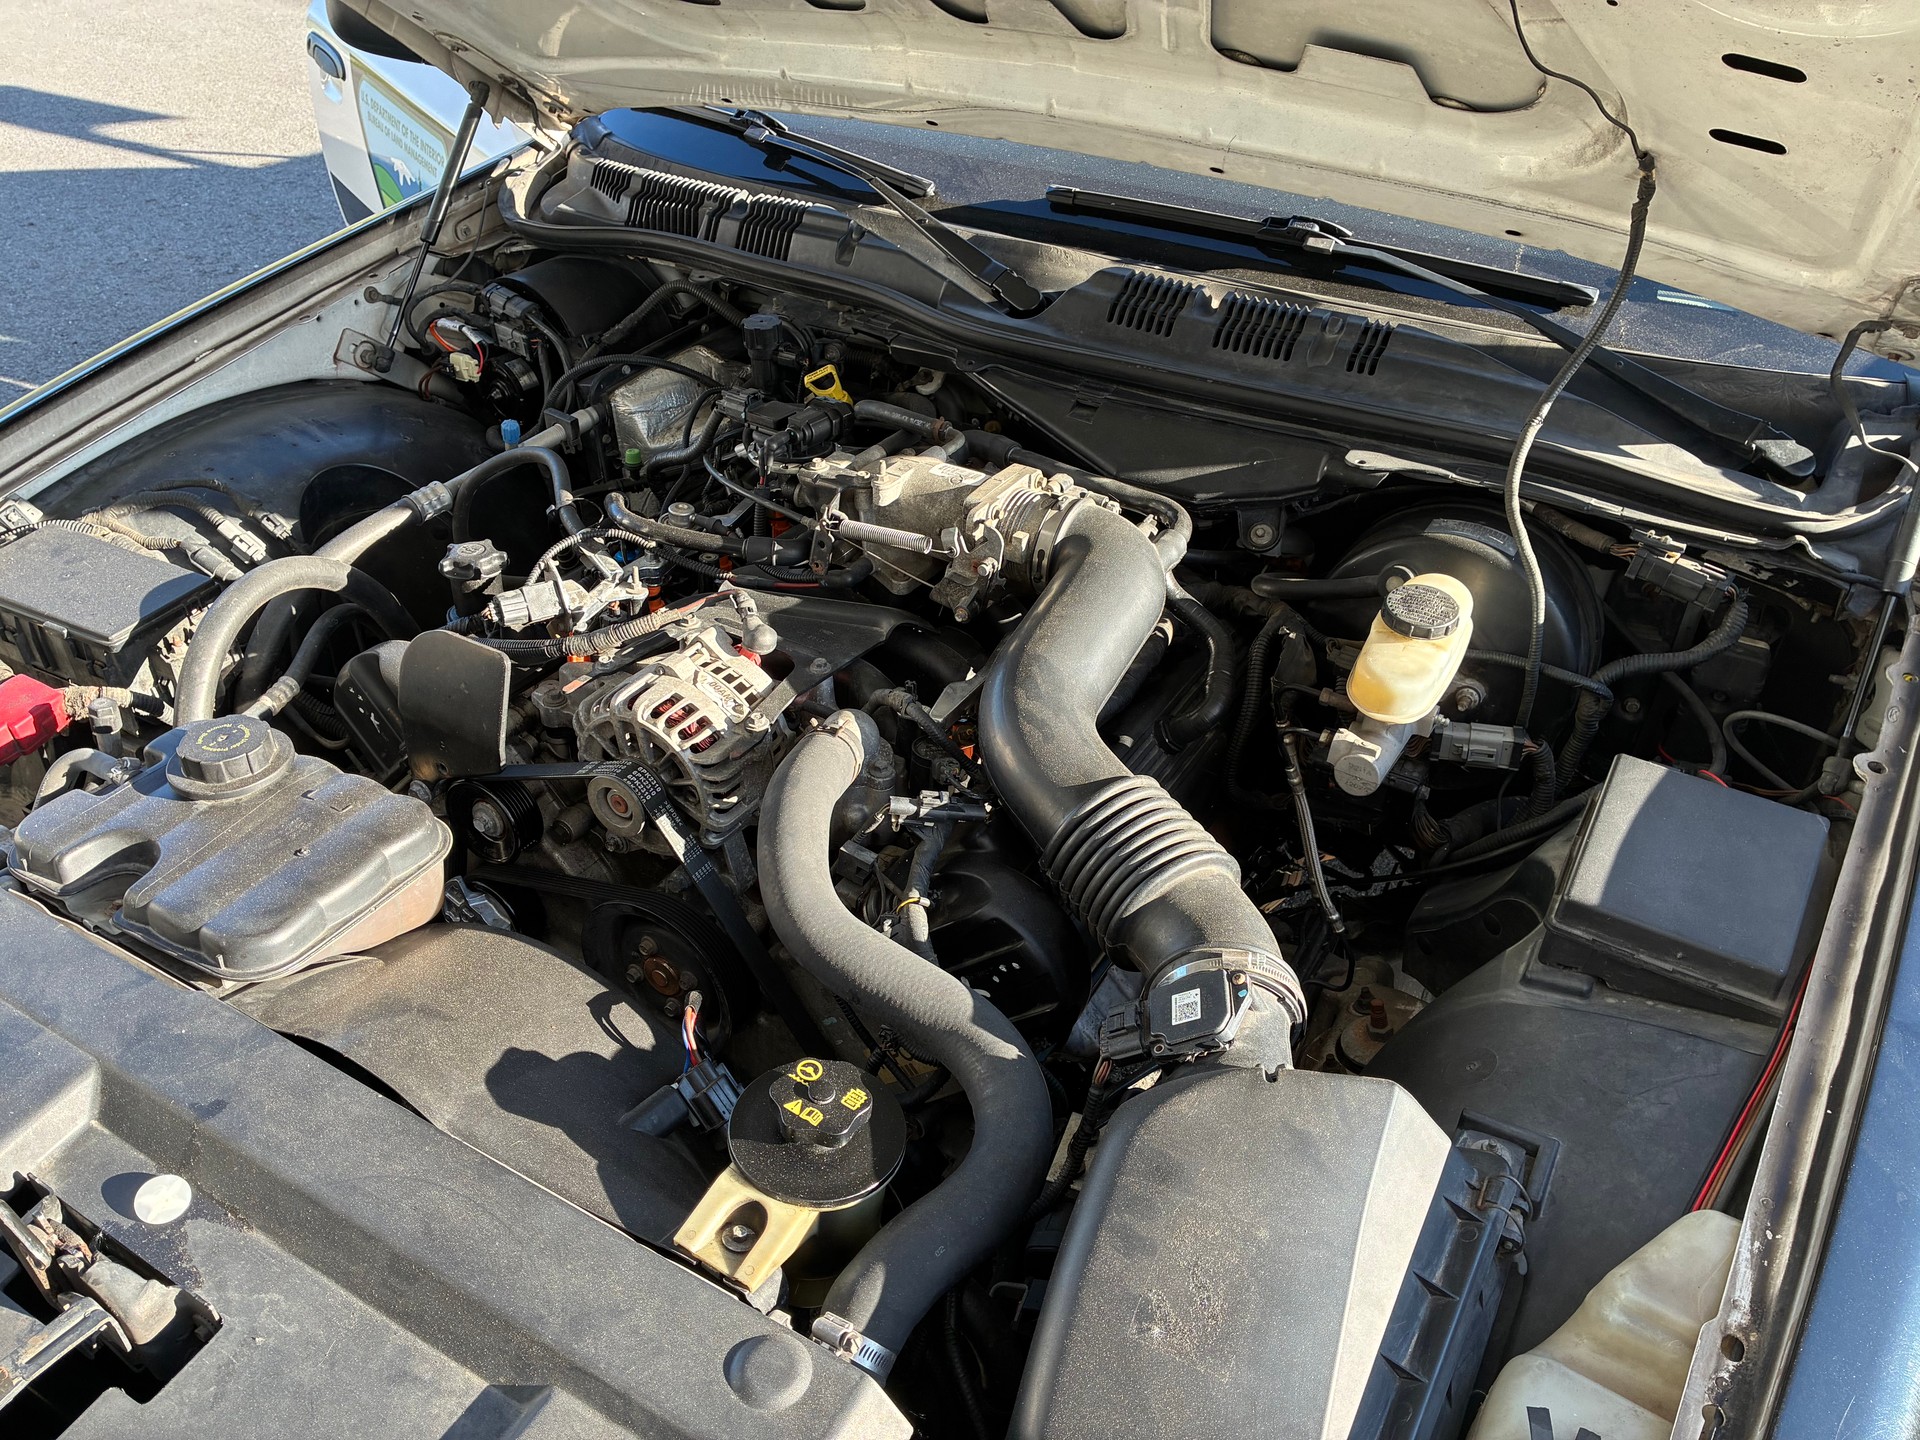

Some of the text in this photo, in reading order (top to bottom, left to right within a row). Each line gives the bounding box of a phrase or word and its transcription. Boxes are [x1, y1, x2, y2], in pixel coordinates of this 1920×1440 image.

[367, 110, 437, 178] BUREAU OF LAND MANAGEMENT
[370, 98, 401, 132] DEPARTMENT
[401, 124, 409, 138] OF
[410, 130, 419, 147] THE
[420, 139, 445, 168] INTERIOR
[627, 774, 651, 800] 6PK2310
[632, 770, 657, 796] 6PK2310
[638, 767, 661, 791] 6PK2310
